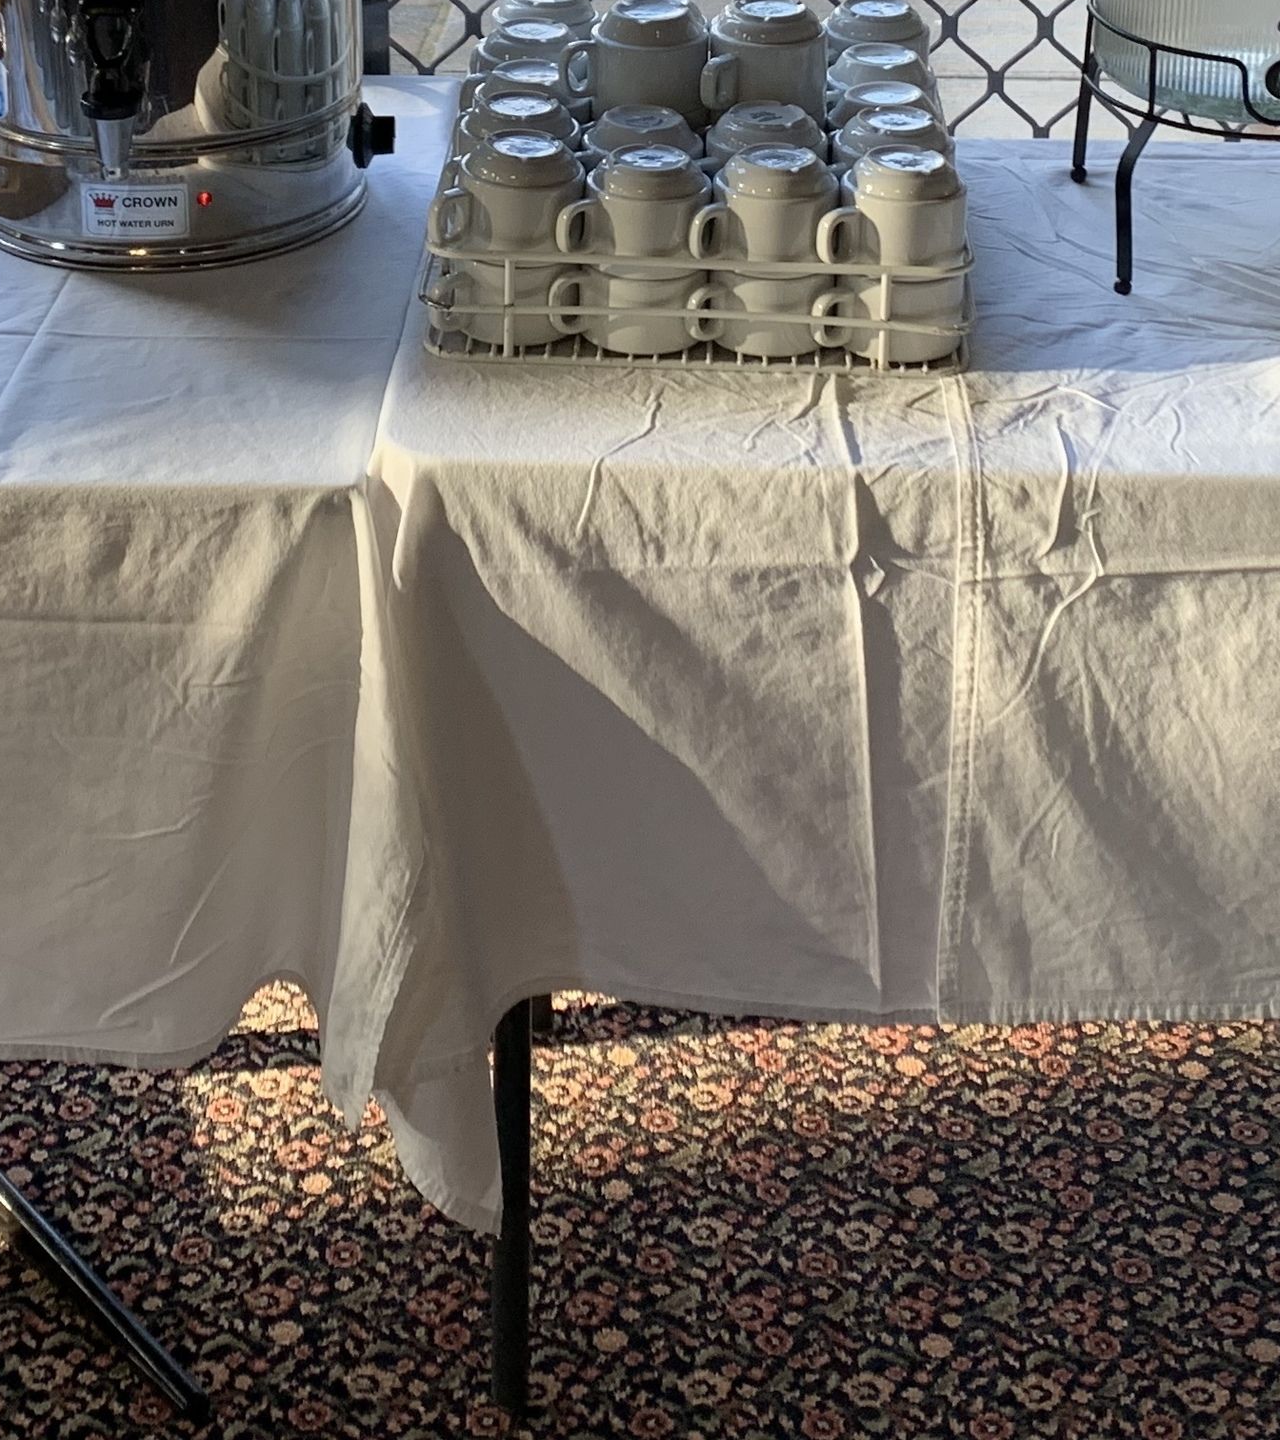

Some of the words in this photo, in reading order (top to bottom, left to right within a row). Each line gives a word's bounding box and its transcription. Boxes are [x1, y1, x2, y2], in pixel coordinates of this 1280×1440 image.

[122, 196, 178, 208] CROWN
[97, 219, 117, 228] HOT
[120, 220, 151, 228] WATER
[154, 220, 175, 228] URN
